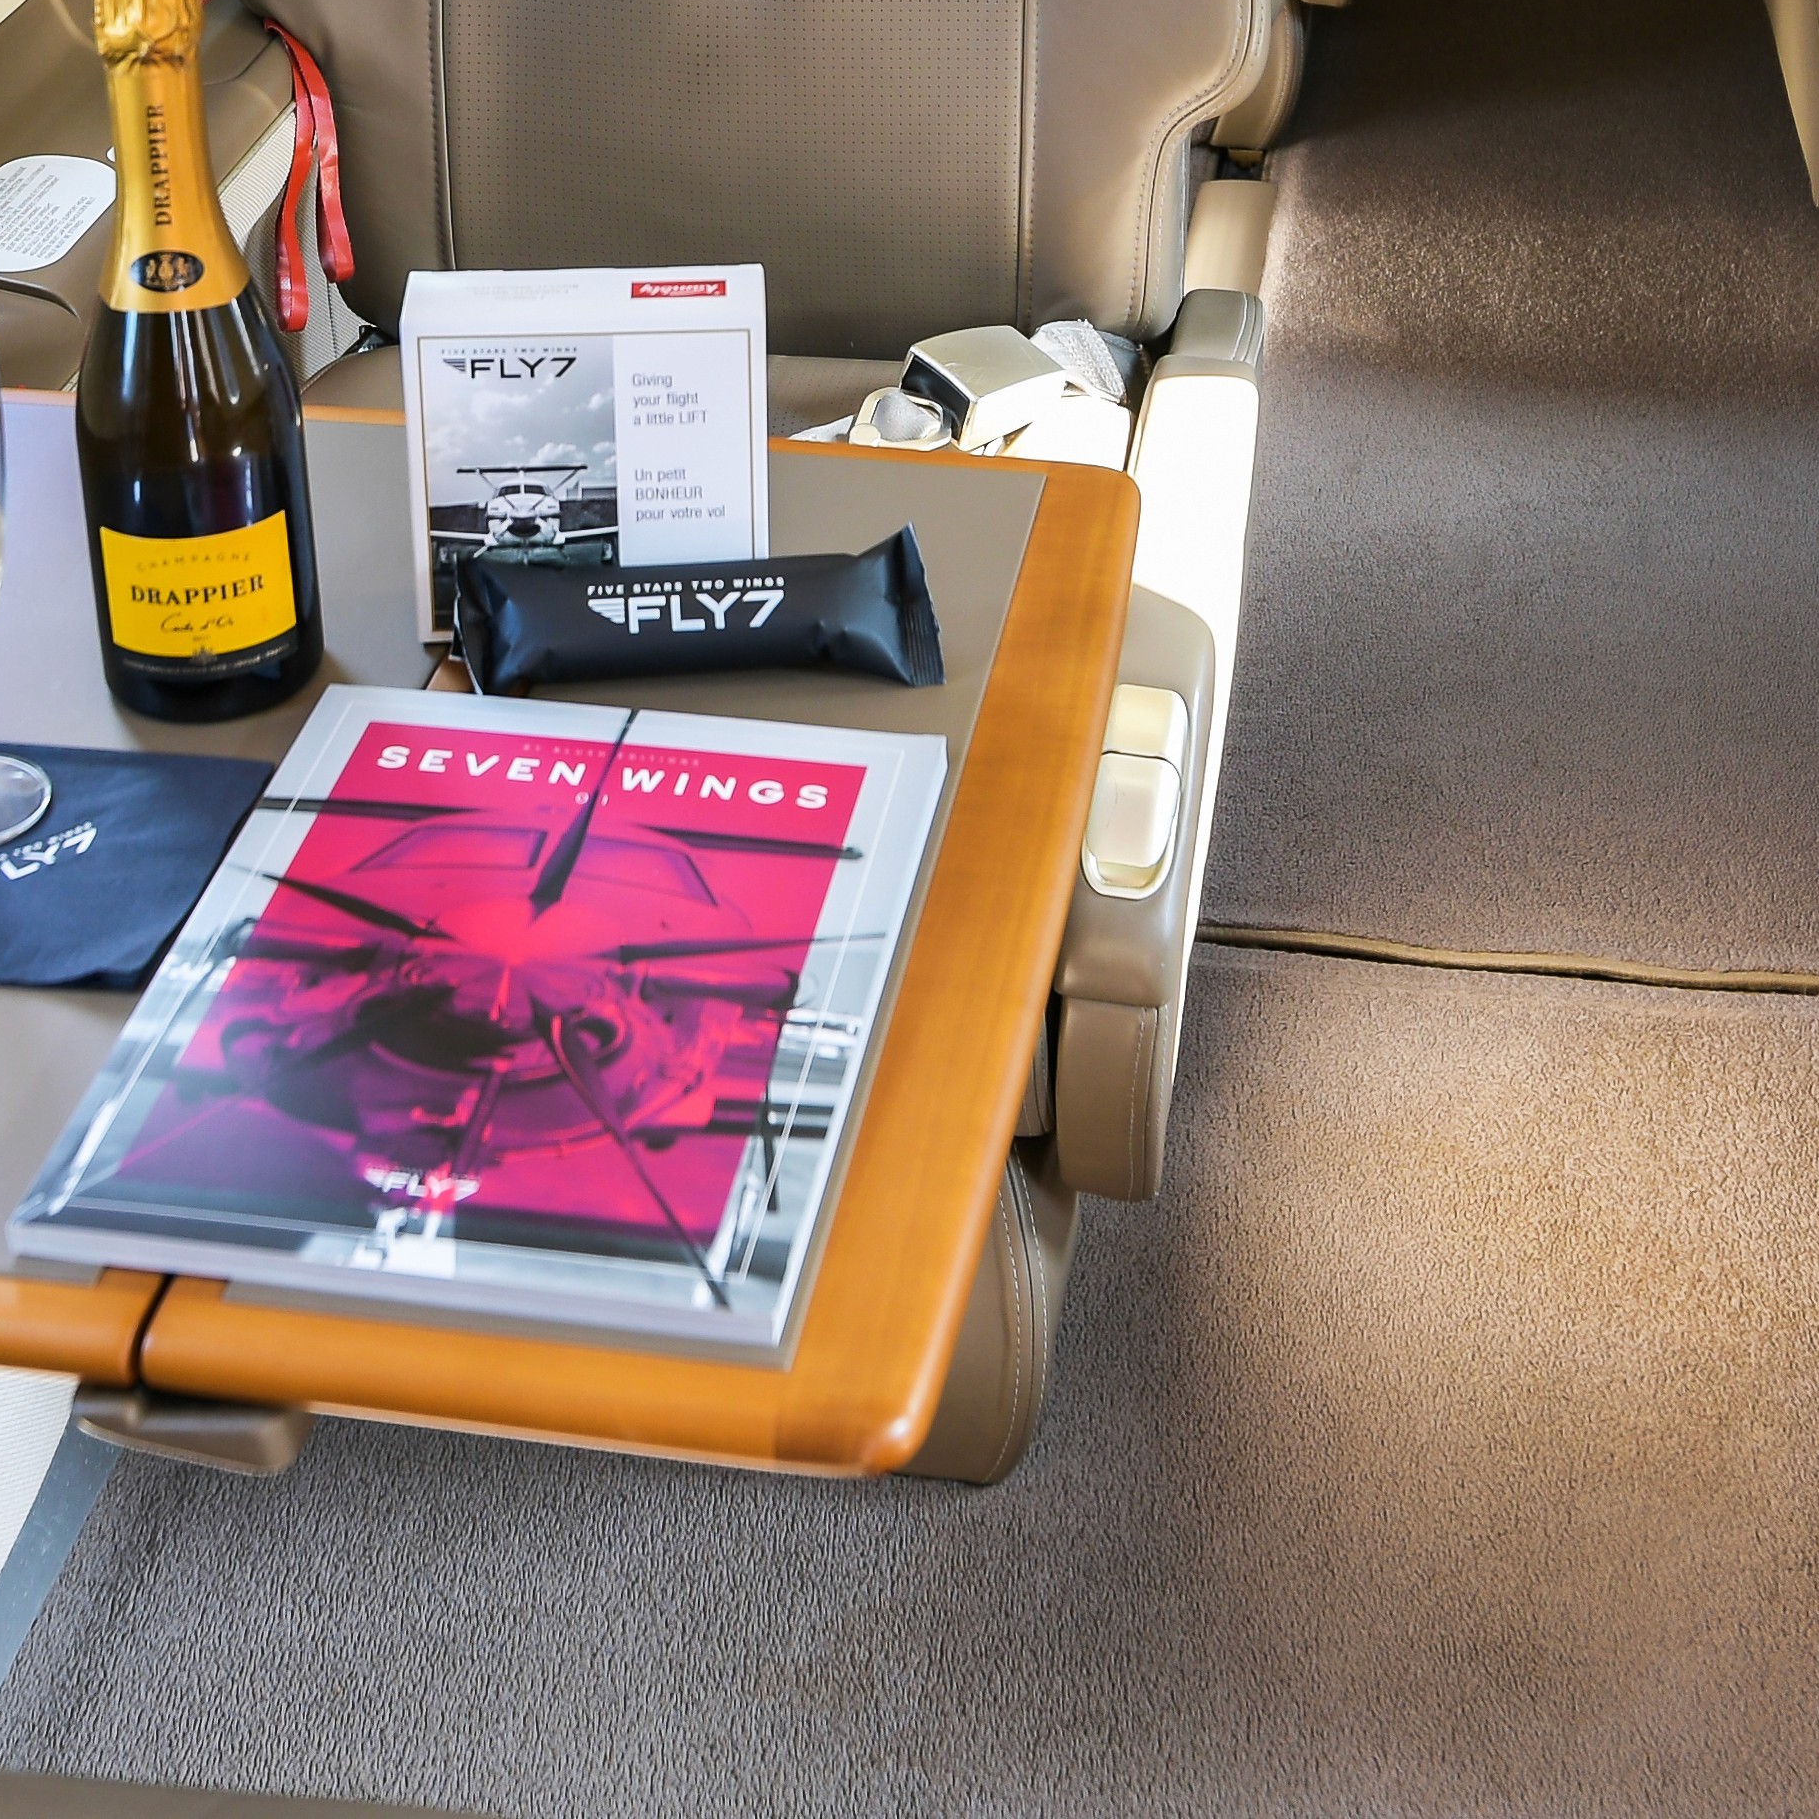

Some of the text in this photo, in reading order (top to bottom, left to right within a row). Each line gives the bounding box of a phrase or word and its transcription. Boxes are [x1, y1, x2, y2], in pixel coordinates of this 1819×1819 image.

[147, 104, 173, 226] DRAPPIER
[470, 357, 577, 379] FLY7
[632, 373, 673, 388] Giving
[633, 392, 699, 408] your flight
[633, 410, 707, 426] a little LIFT
[634, 468, 686, 483] Un petit
[635, 486, 703, 501] BONHEUR
[636, 504, 726, 522] pour votre vol
[131, 573, 265, 606] DRAPPIER
[587, 576, 785, 596] FIVE STARS TWO WINGS
[627, 589, 785, 634] FLY7
[376, 745, 830, 810] SEVEN WINGS
